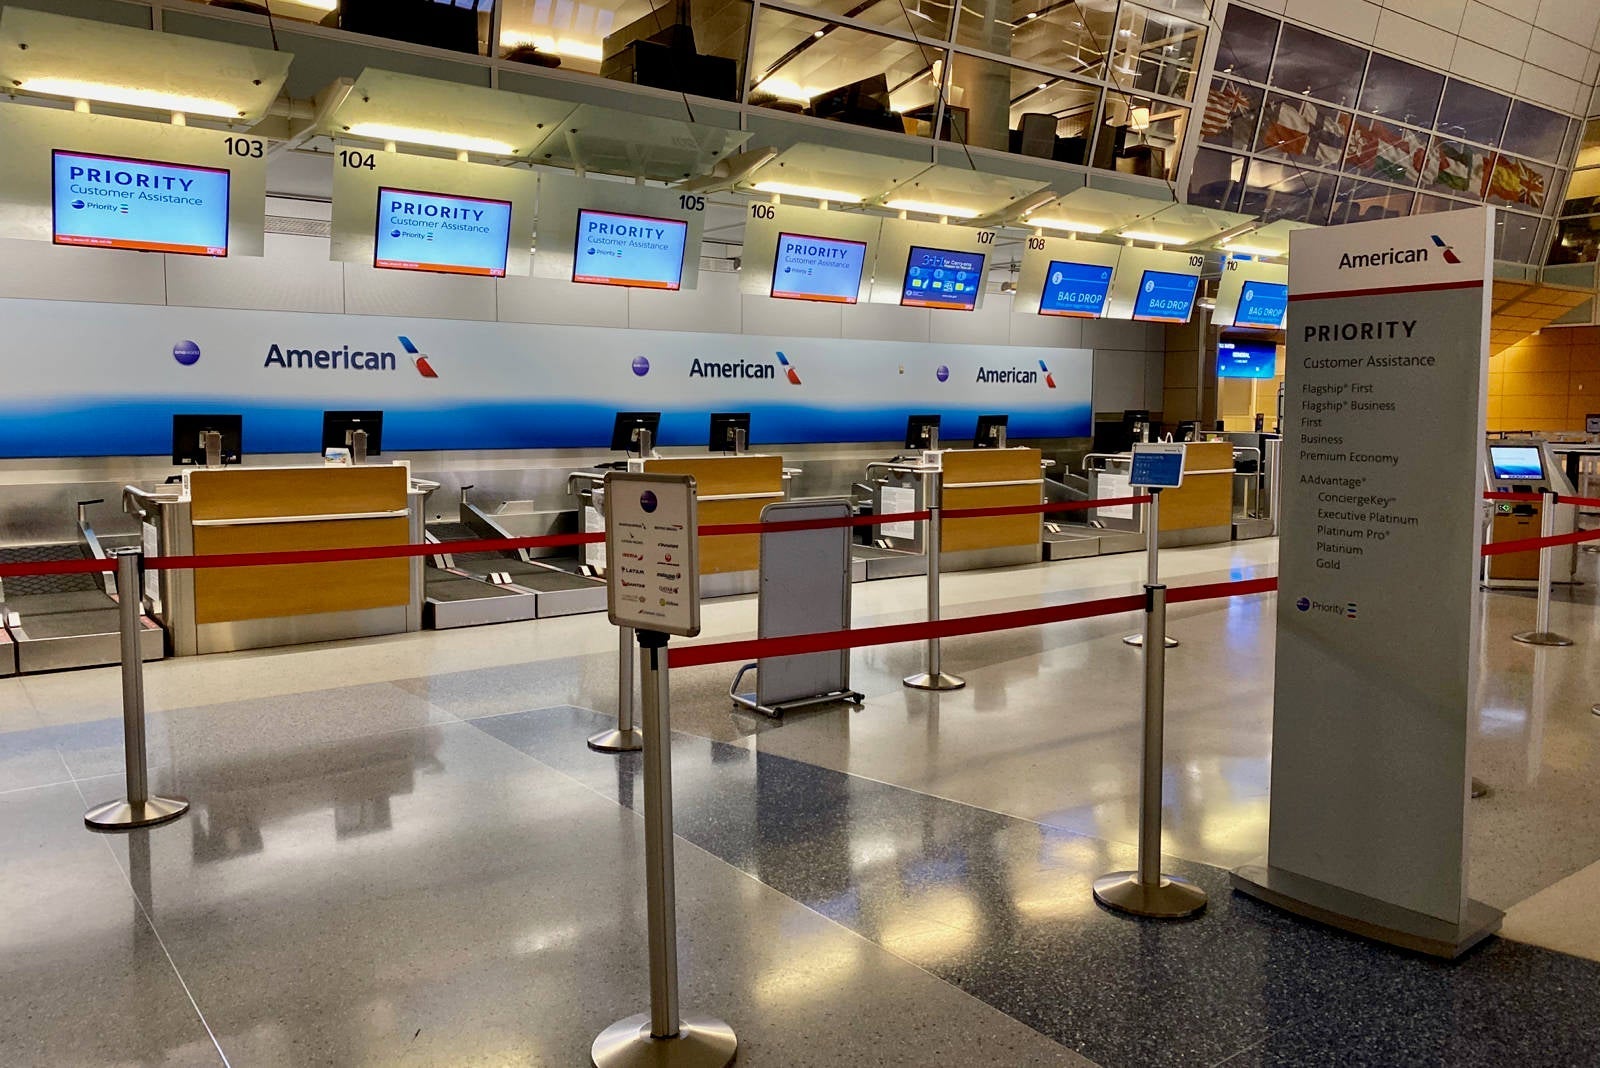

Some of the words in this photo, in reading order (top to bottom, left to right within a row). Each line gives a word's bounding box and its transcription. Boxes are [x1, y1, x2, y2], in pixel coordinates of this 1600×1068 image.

[224, 137, 264, 158] 103
[339, 150, 376, 170] 104
[70, 166, 194, 192] PRIORITY
[70, 184, 135, 200] Customer
[138, 191, 203, 206] Assistance
[87, 202, 118, 212] Priority
[679, 194, 705, 212] 105
[391, 201, 484, 222] PRIORITY
[751, 204, 775, 220] 106
[390, 216, 439, 229] Customer
[441, 222, 490, 234] Assistance
[588, 221, 665, 240] PRIORITY
[402, 231, 426, 240] Priority
[587, 235, 627, 247] Customer
[628, 240, 669, 251] Assistance
[976, 231, 995, 244] 107
[786, 243, 848, 259] PRIORITY
[1028, 237, 1045, 250] 108
[785, 256, 817, 266] Customer
[817, 259, 850, 269] Assistance
[1189, 255, 1203, 267] 109
[1227, 261, 1238, 271] 110
[1338, 247, 1428, 270] American
[1057, 291, 1076, 302] BAG
[1078, 293, 1102, 304] DROP
[1149, 299, 1166, 308] BAG
[1167, 300, 1188, 310] DROP
[1248, 306, 1263, 316] BAG
[1263, 308, 1283, 317] DROP
[1304, 320, 1417, 343] PRIORITY
[264, 344, 396, 370] American
[1303, 355, 1364, 369] Customer
[1366, 354, 1436, 368] Assistance
[689, 358, 775, 379] American
[976, 367, 1037, 384] American
[1351, 383, 1374, 393] First
[1350, 400, 1396, 411] Business
[1301, 417, 1322, 428] First
[1300, 433, 1344, 444] Business
[1300, 450, 1346, 461] Premium
[1349, 452, 1399, 467] Economy
[1318, 508, 1366, 522] Executive
[1369, 512, 1419, 526] Platinum
[1317, 524, 1363, 538] Platinum
[1316, 541, 1363, 555] Platinum
[1316, 558, 1341, 570] Gold
[1312, 601, 1344, 615] Priority
